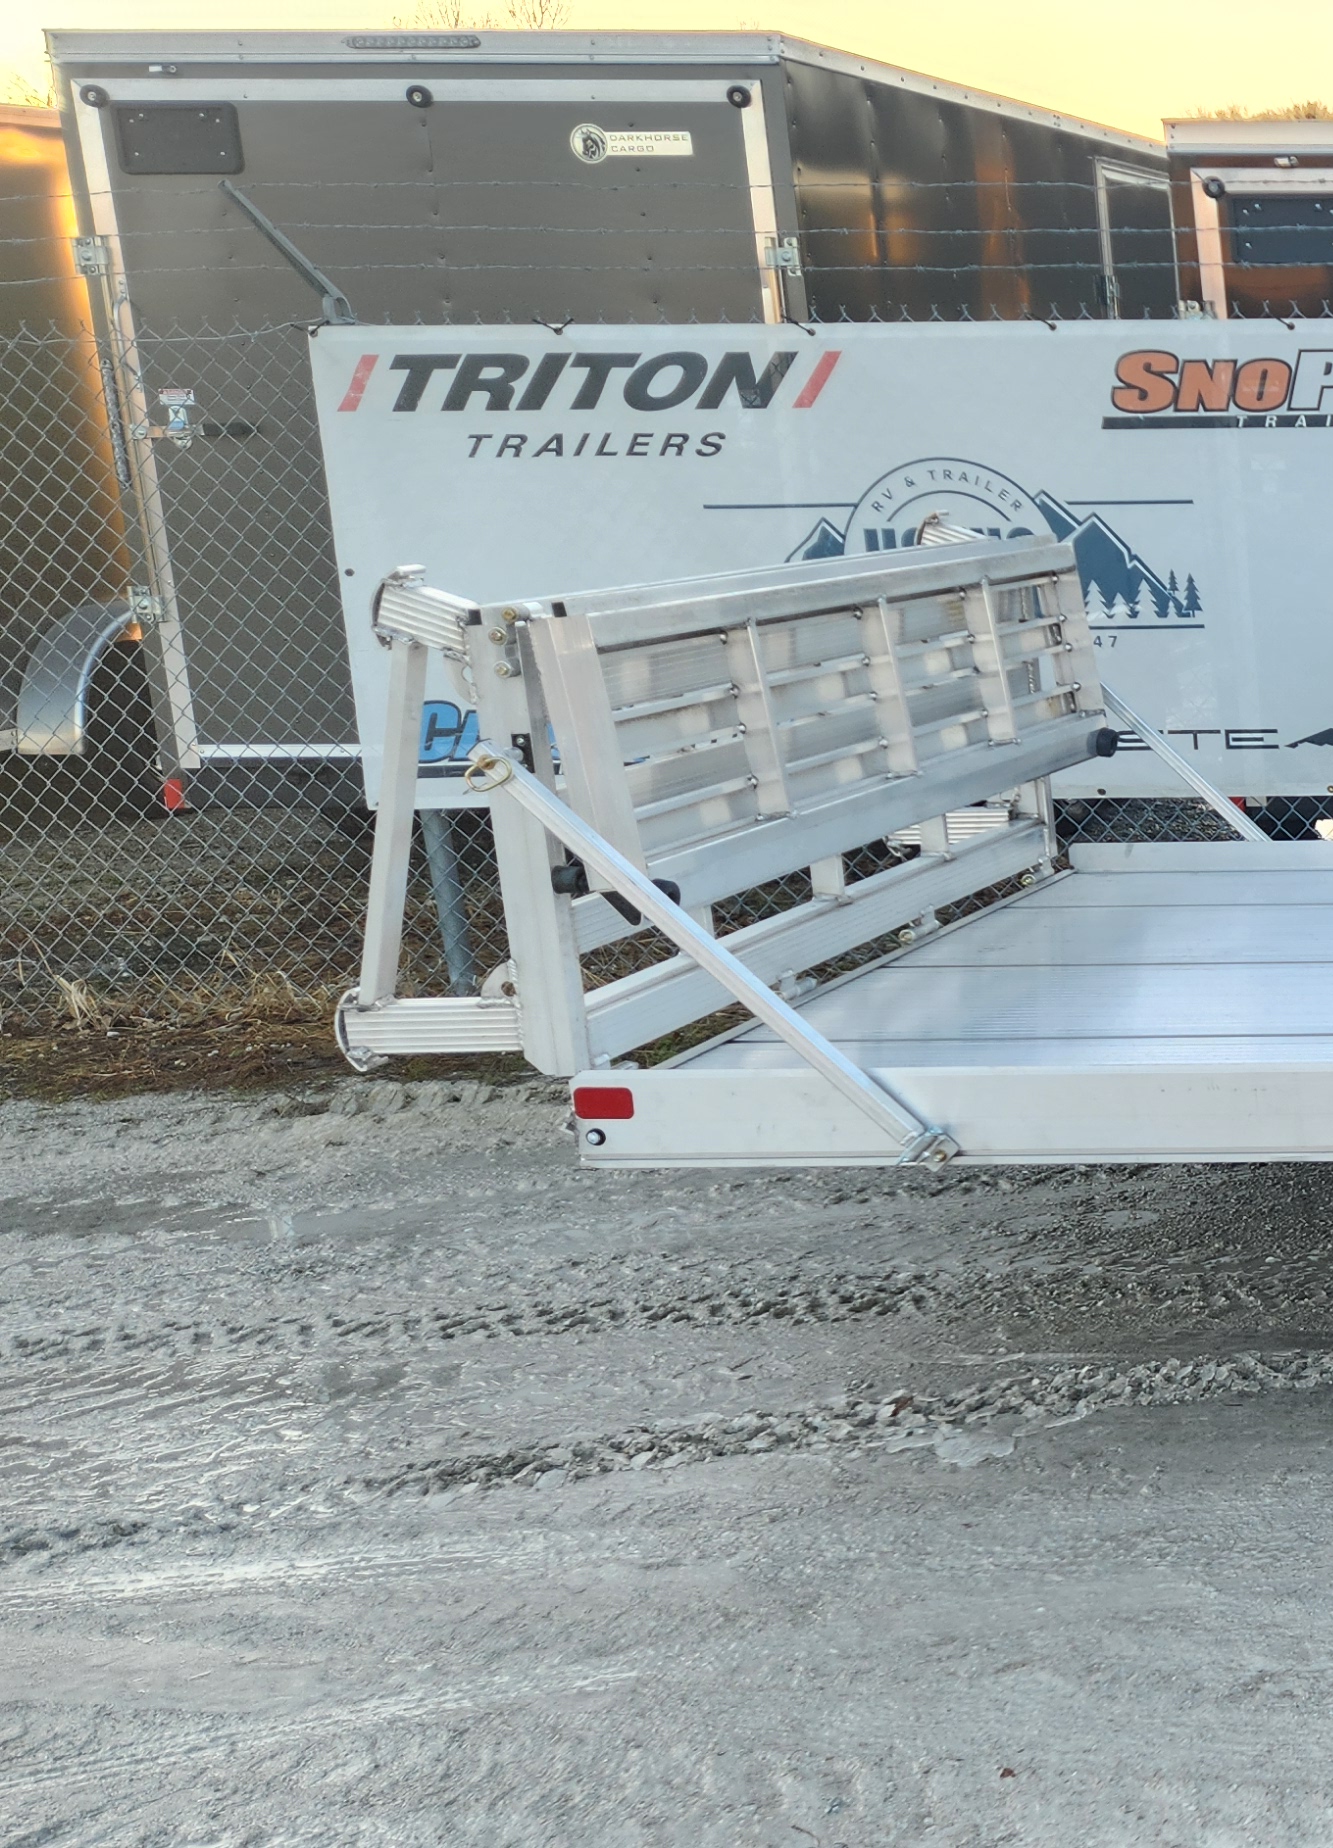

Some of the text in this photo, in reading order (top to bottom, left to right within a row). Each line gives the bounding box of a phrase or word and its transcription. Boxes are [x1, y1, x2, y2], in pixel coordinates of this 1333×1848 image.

[608, 133, 689, 142] DARKHORSE
[611, 144, 655, 153] CARGO
[388, 351, 800, 412] TRITON
[466, 432, 727, 458] TRAILERS
[870, 468, 1023, 513] RV & TRAILER
